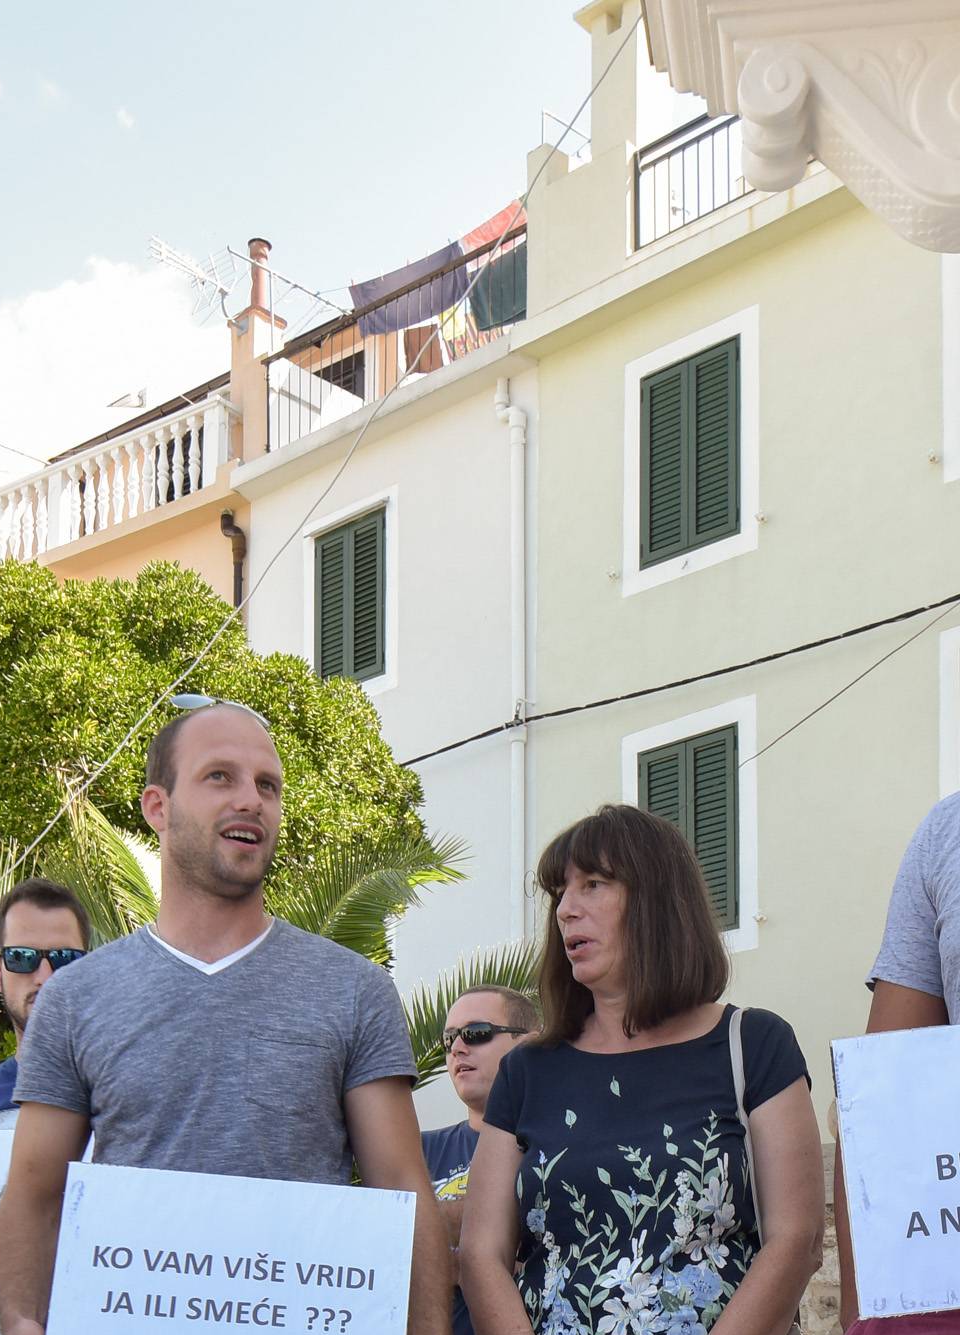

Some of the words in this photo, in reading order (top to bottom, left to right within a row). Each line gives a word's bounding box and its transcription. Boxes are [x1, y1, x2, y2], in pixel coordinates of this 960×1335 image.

[936, 1152, 960, 1181] B
[907, 1211, 930, 1238] A
[92, 1245, 134, 1270] KO
[143, 1248, 213, 1277] VAM
[223, 1252, 287, 1283] VIŠE
[295, 1262, 375, 1291] VRIDI
[100, 1290, 135, 1315] JA
[144, 1293, 177, 1319] ILI
[185, 1297, 288, 1328] SMEĆE
[305, 1307, 354, 1334] ???
